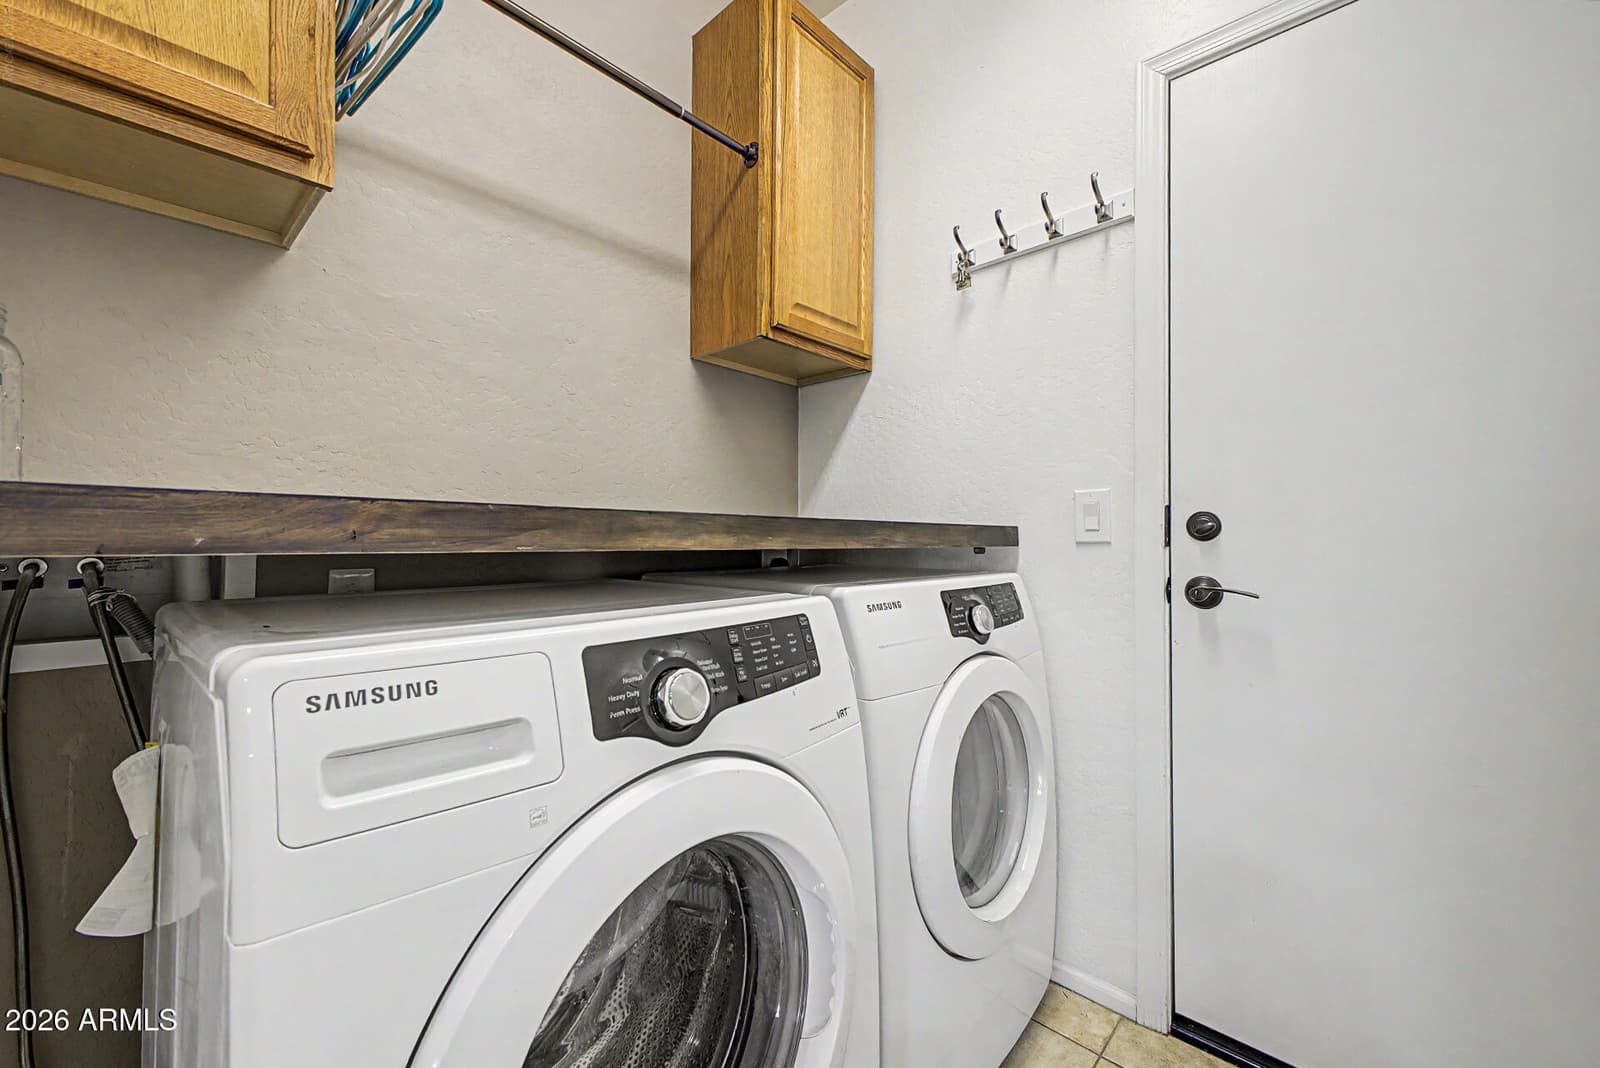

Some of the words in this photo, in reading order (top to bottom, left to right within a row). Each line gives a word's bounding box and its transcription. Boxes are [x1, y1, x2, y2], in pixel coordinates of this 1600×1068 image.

[866, 600, 902, 613] SAMSUNG
[622, 674, 643, 684] Normal
[305, 679, 438, 714] SAMSUNG
[608, 694, 625, 703] Heavy
[626, 690, 640, 698] Duty
[609, 710, 625, 719] Perm
[625, 706, 641, 715] Press
